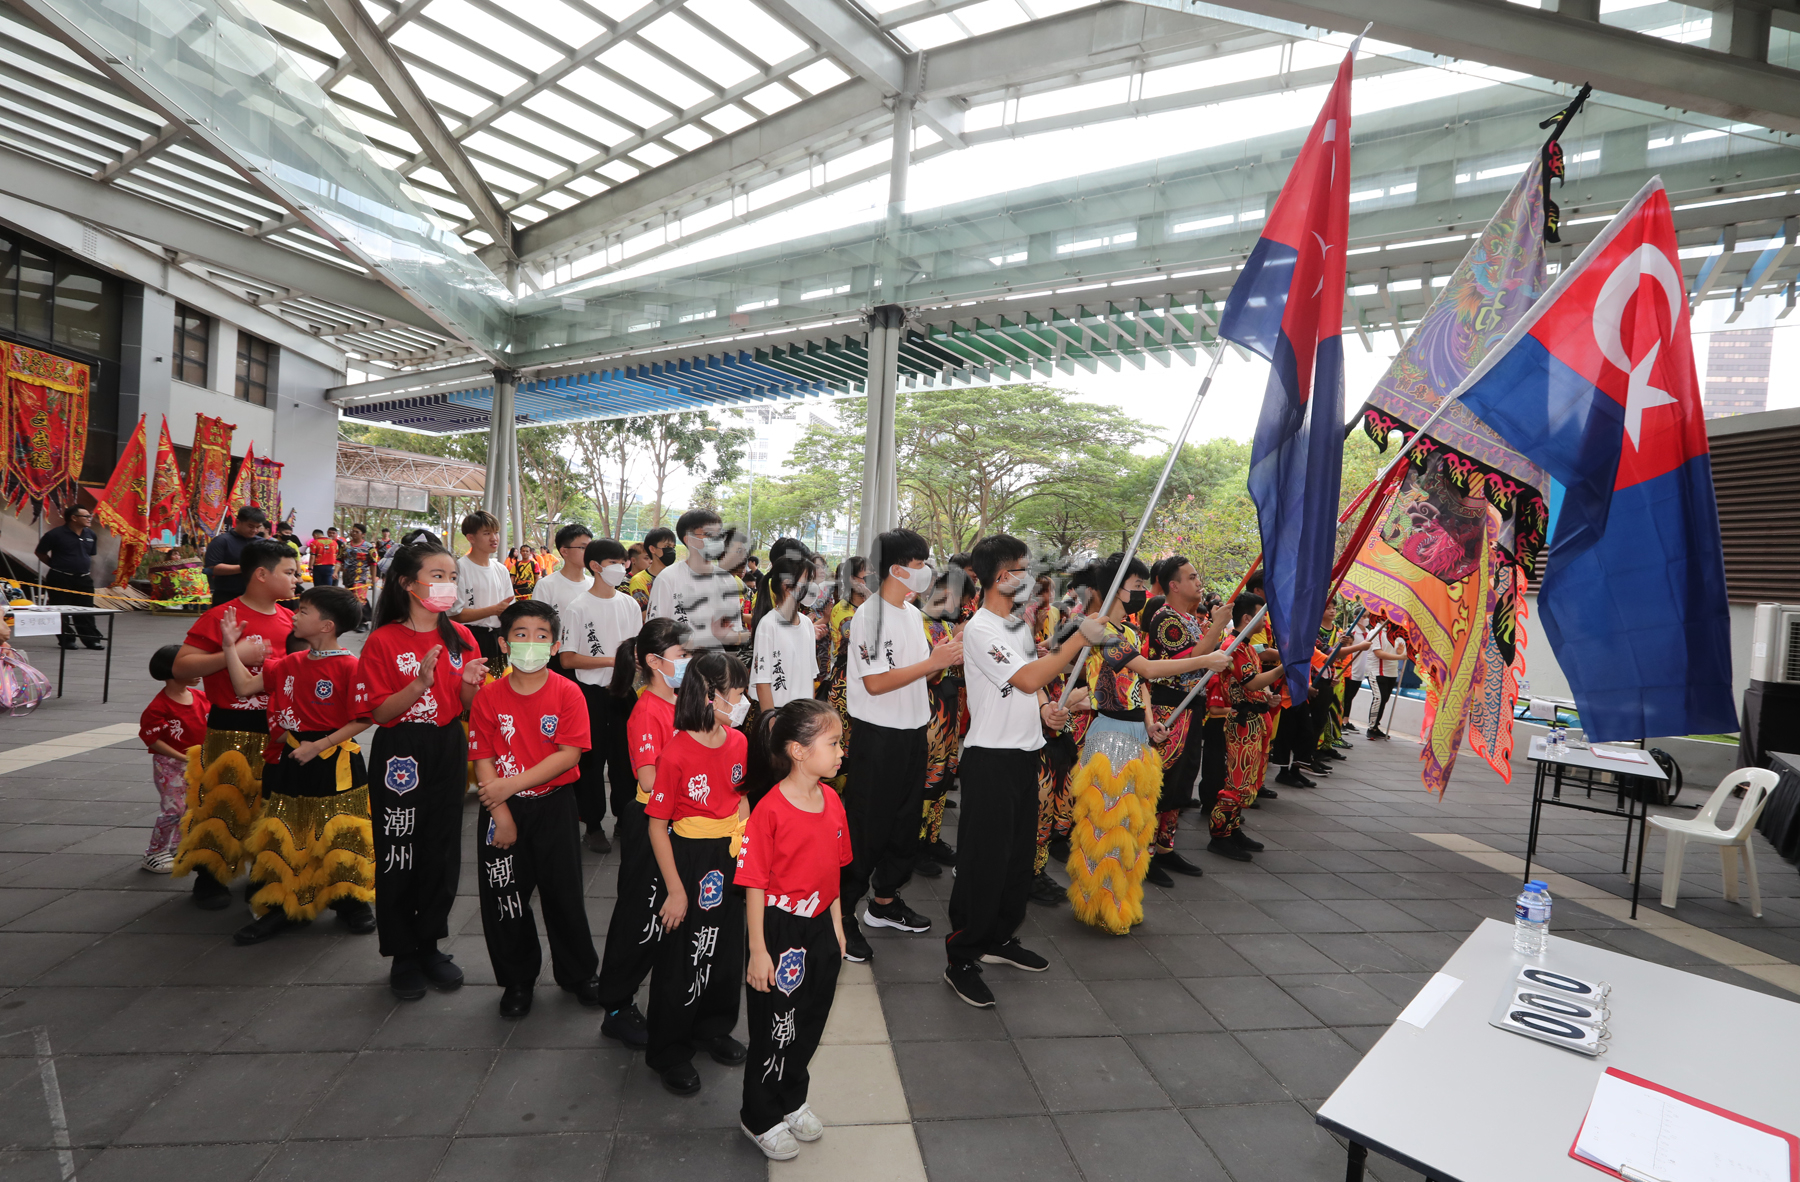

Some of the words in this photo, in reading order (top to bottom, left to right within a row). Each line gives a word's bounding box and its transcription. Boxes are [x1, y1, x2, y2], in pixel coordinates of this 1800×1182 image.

[383, 806, 416, 874] 潮州
[485, 854, 523, 922] 潮州
[684, 924, 720, 1006] 潮州
[761, 1007, 796, 1084] 潮州
